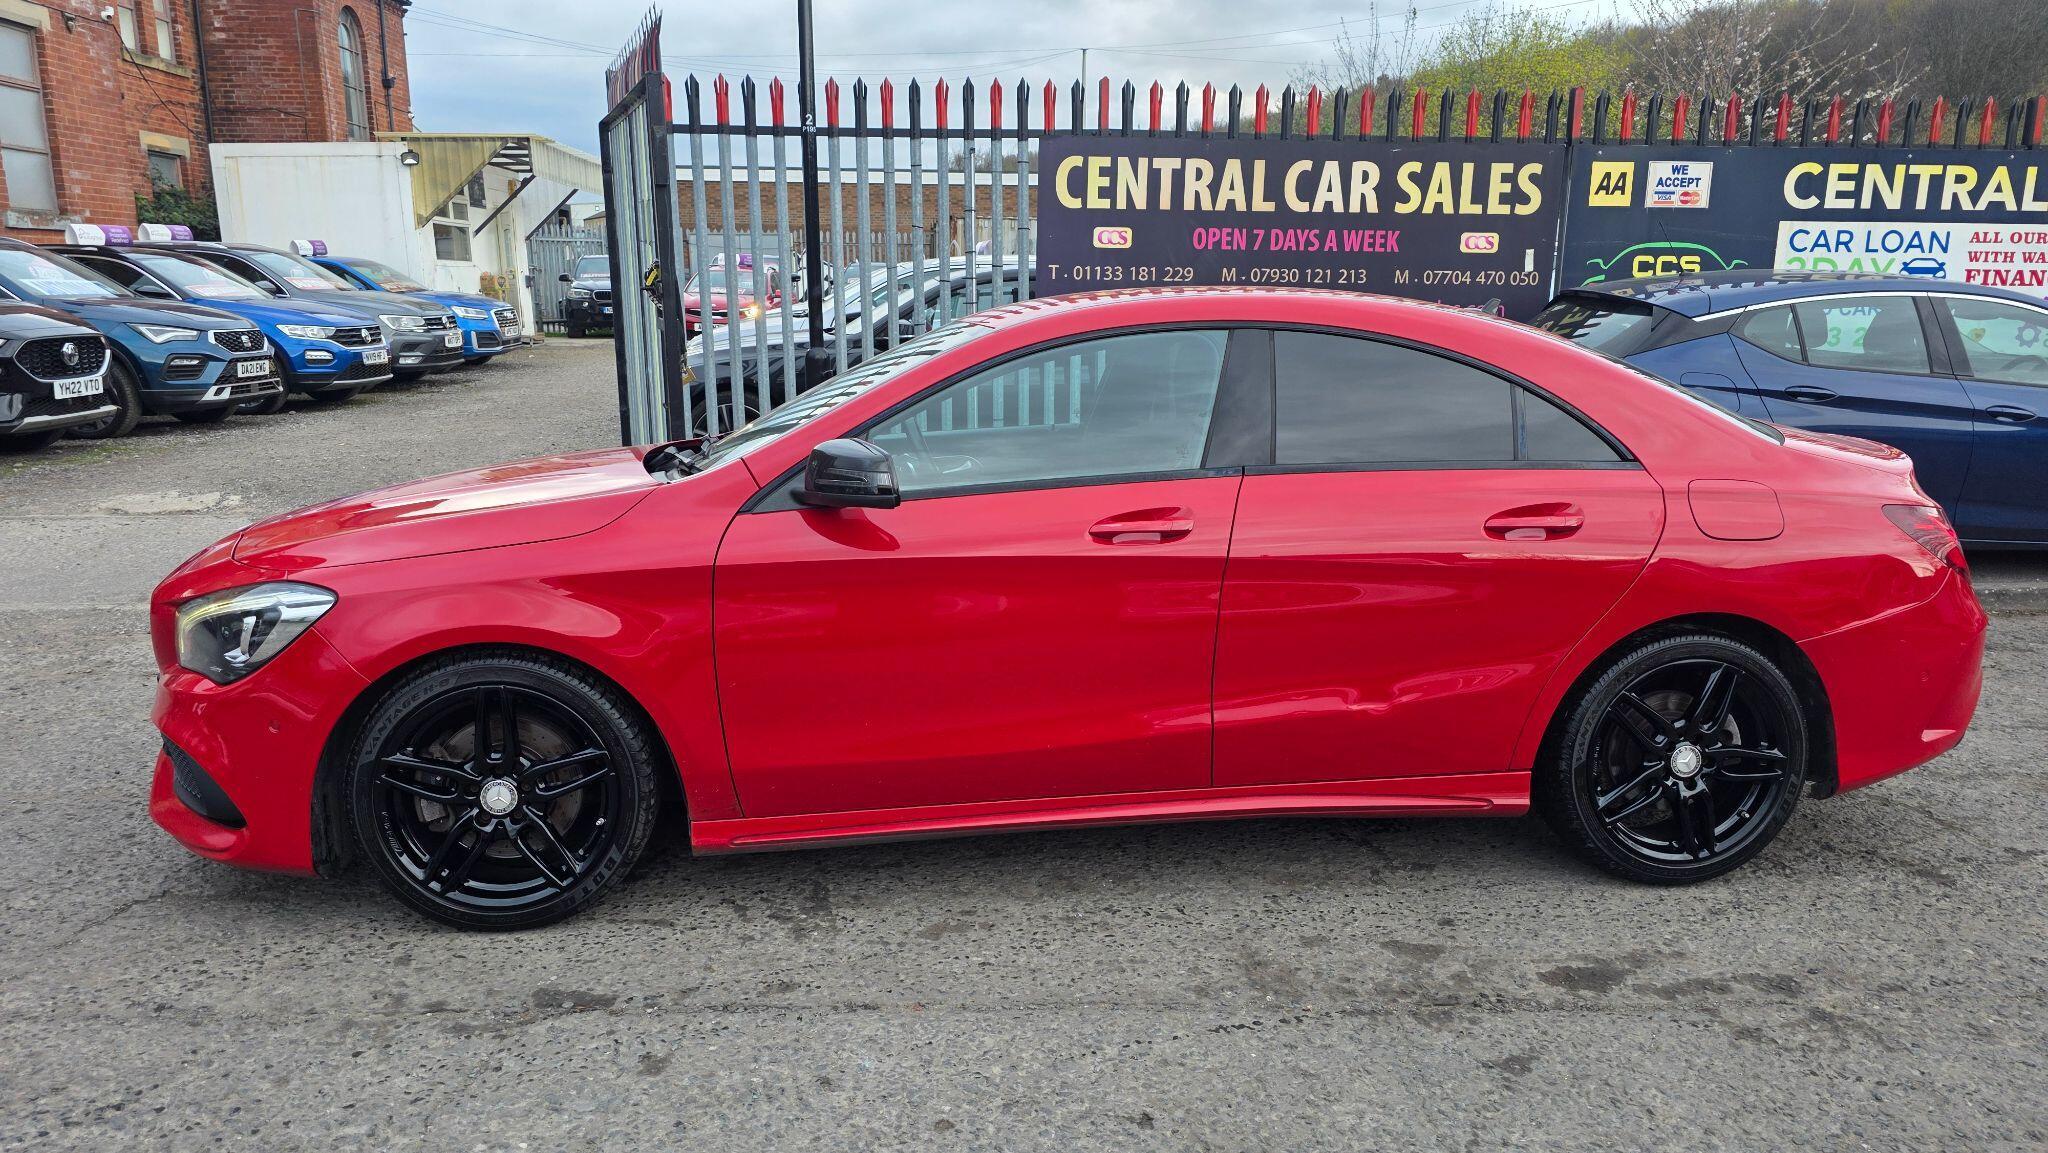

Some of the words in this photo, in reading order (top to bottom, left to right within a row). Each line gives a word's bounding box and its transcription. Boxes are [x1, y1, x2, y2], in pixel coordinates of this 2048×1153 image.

[805, 113, 813, 125] 2
[1671, 164, 1690, 176] WE
[1055, 155, 1277, 212] CENTRAL
[1284, 159, 1380, 214] CAR
[1394, 161, 1544, 216] SALES
[1594, 171, 1628, 196] AA
[1656, 176, 1702, 188] ACCEPT
[1783, 161, 2048, 211] CENTRAL
[1192, 227, 1247, 251] OPEN
[1253, 229, 1265, 251] 7
[1270, 228, 1320, 252] DAYS
[1324, 229, 1338, 252] A
[1343, 230, 1400, 253] WEEK
[1788, 228, 1854, 253] CAR
[1864, 230, 1951, 254] LOAN
[1969, 231, 2004, 244] ALL
[2009, 231, 2048, 244] OUR
[1967, 250, 2016, 263] WITH
[1073, 265, 1123, 281] 01133
[1130, 266, 1156, 282] 181
[1163, 266, 1194, 282] 229
[1632, 255, 1701, 278] CCS
[1250, 268, 1299, 283] 07930
[1305, 268, 1331, 283] 121
[1337, 269, 1367, 284] 213
[1423, 270, 1471, 285] 07704
[1475, 271, 1505, 285] 470
[1510, 271, 1539, 286] 050
[1964, 268, 2048, 287] FINAN
[59, 381, 82, 396] YH22
[83, 378, 100, 393] VTO
